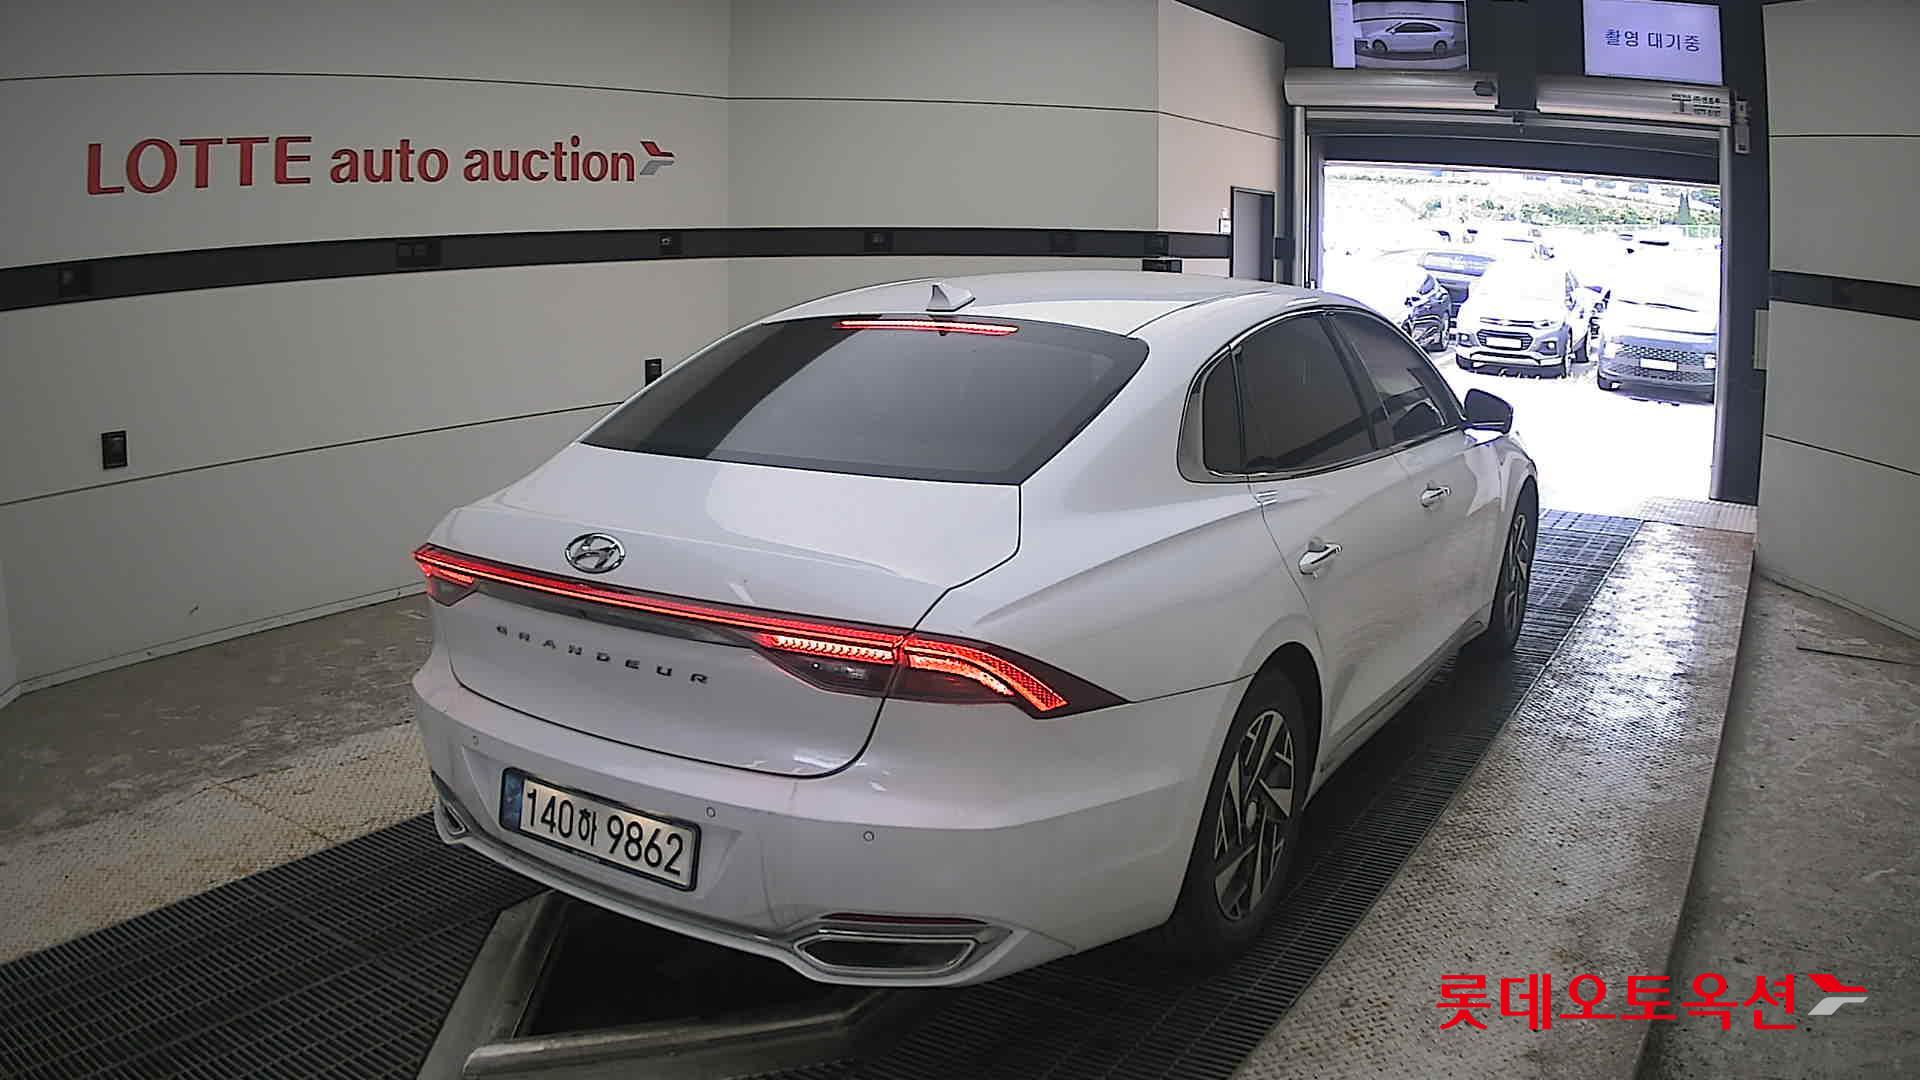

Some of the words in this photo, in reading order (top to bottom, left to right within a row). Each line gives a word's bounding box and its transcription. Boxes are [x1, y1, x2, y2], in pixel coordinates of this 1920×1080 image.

[1647, 32, 1700, 52] 대기중
[87, 136, 312, 195] LOTTE
[330, 138, 449, 184] auto
[462, 136, 637, 183] auction
[496, 625, 708, 684] GRANDEUR
[527, 788, 598, 846] 140하
[607, 814, 683, 877] 9862
